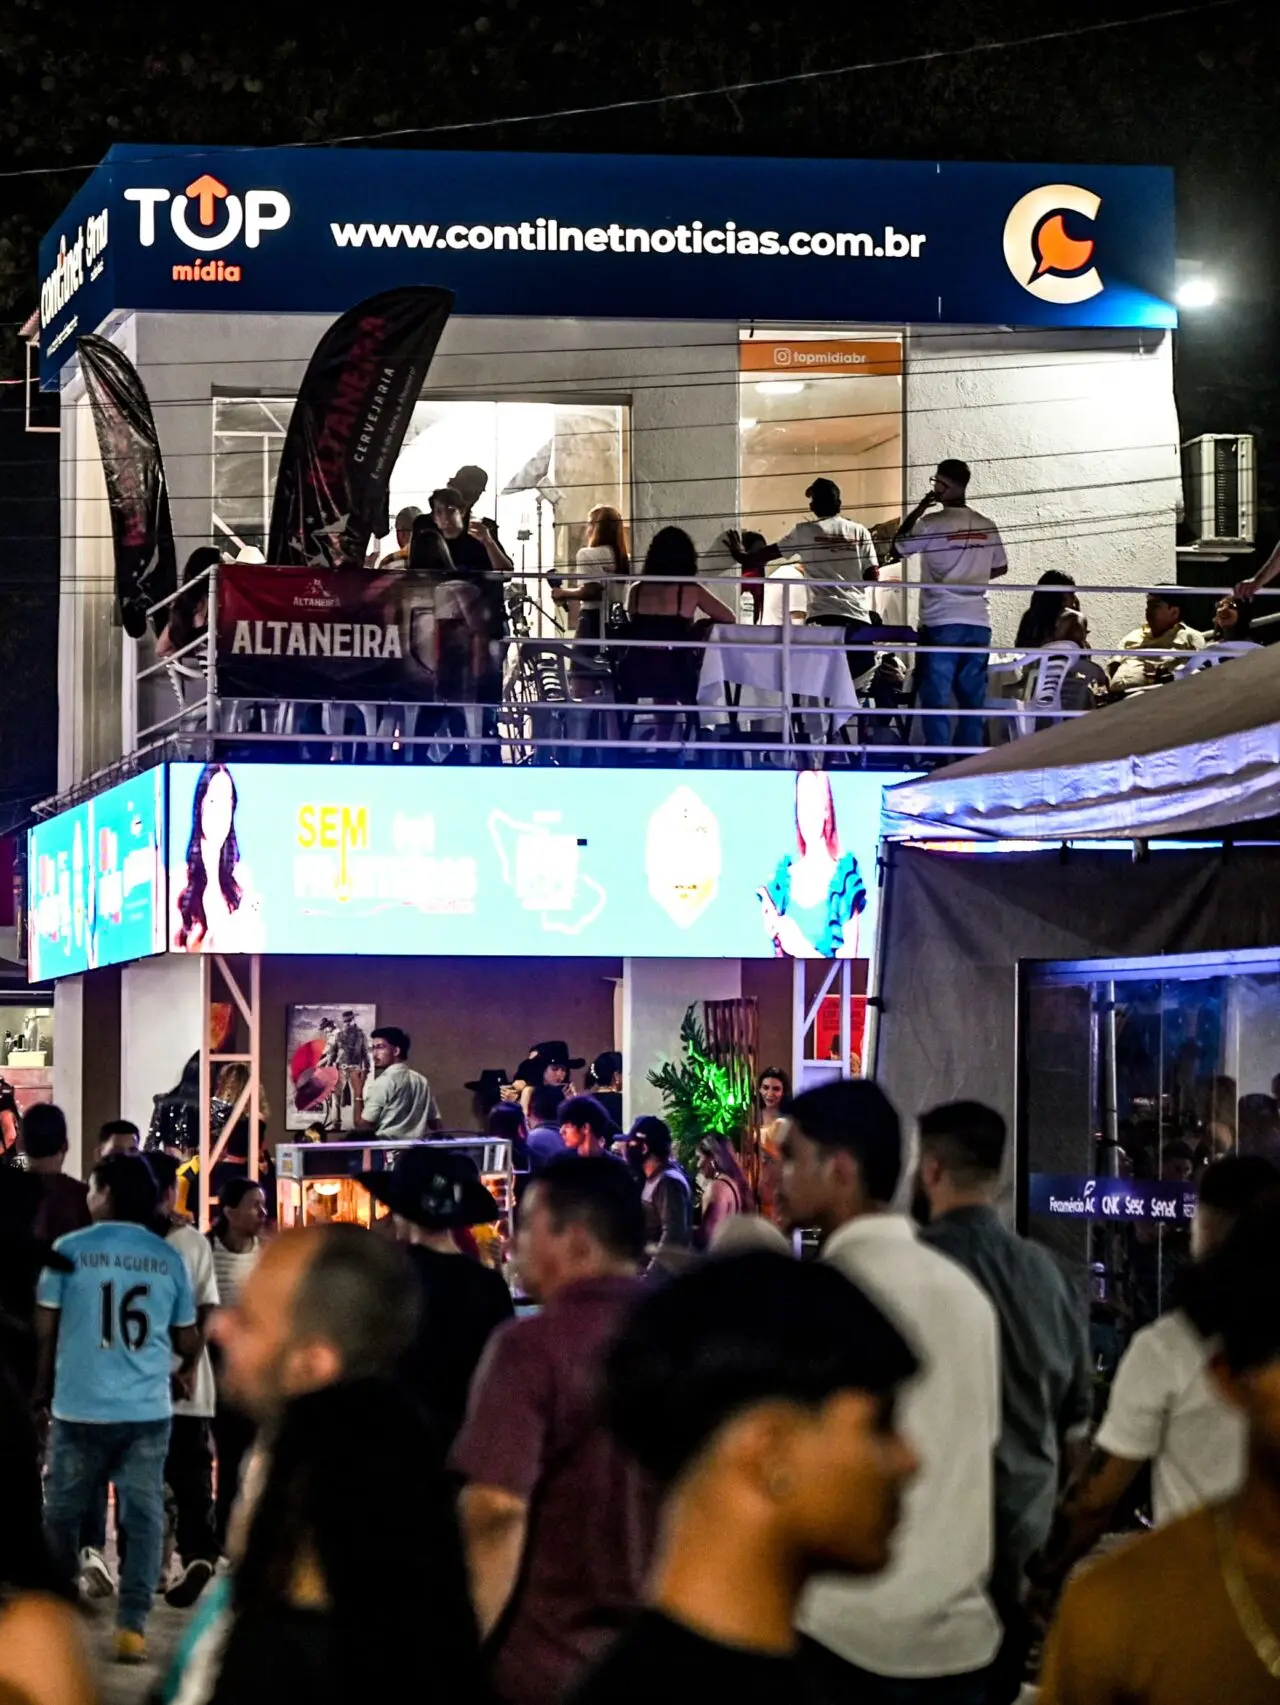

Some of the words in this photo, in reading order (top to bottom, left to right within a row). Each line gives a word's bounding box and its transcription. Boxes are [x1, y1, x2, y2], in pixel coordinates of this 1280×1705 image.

[330, 218, 926, 258] www.contilnetnoticias.com.br
[172, 258, 241, 282] mídia
[354, 367, 396, 463] CERVEJARIA
[231, 620, 403, 659] ALTANEIRA
[297, 805, 369, 849] SEM
[1124, 1196, 1145, 1215] Sesc
[99, 1279, 152, 1352] 16
